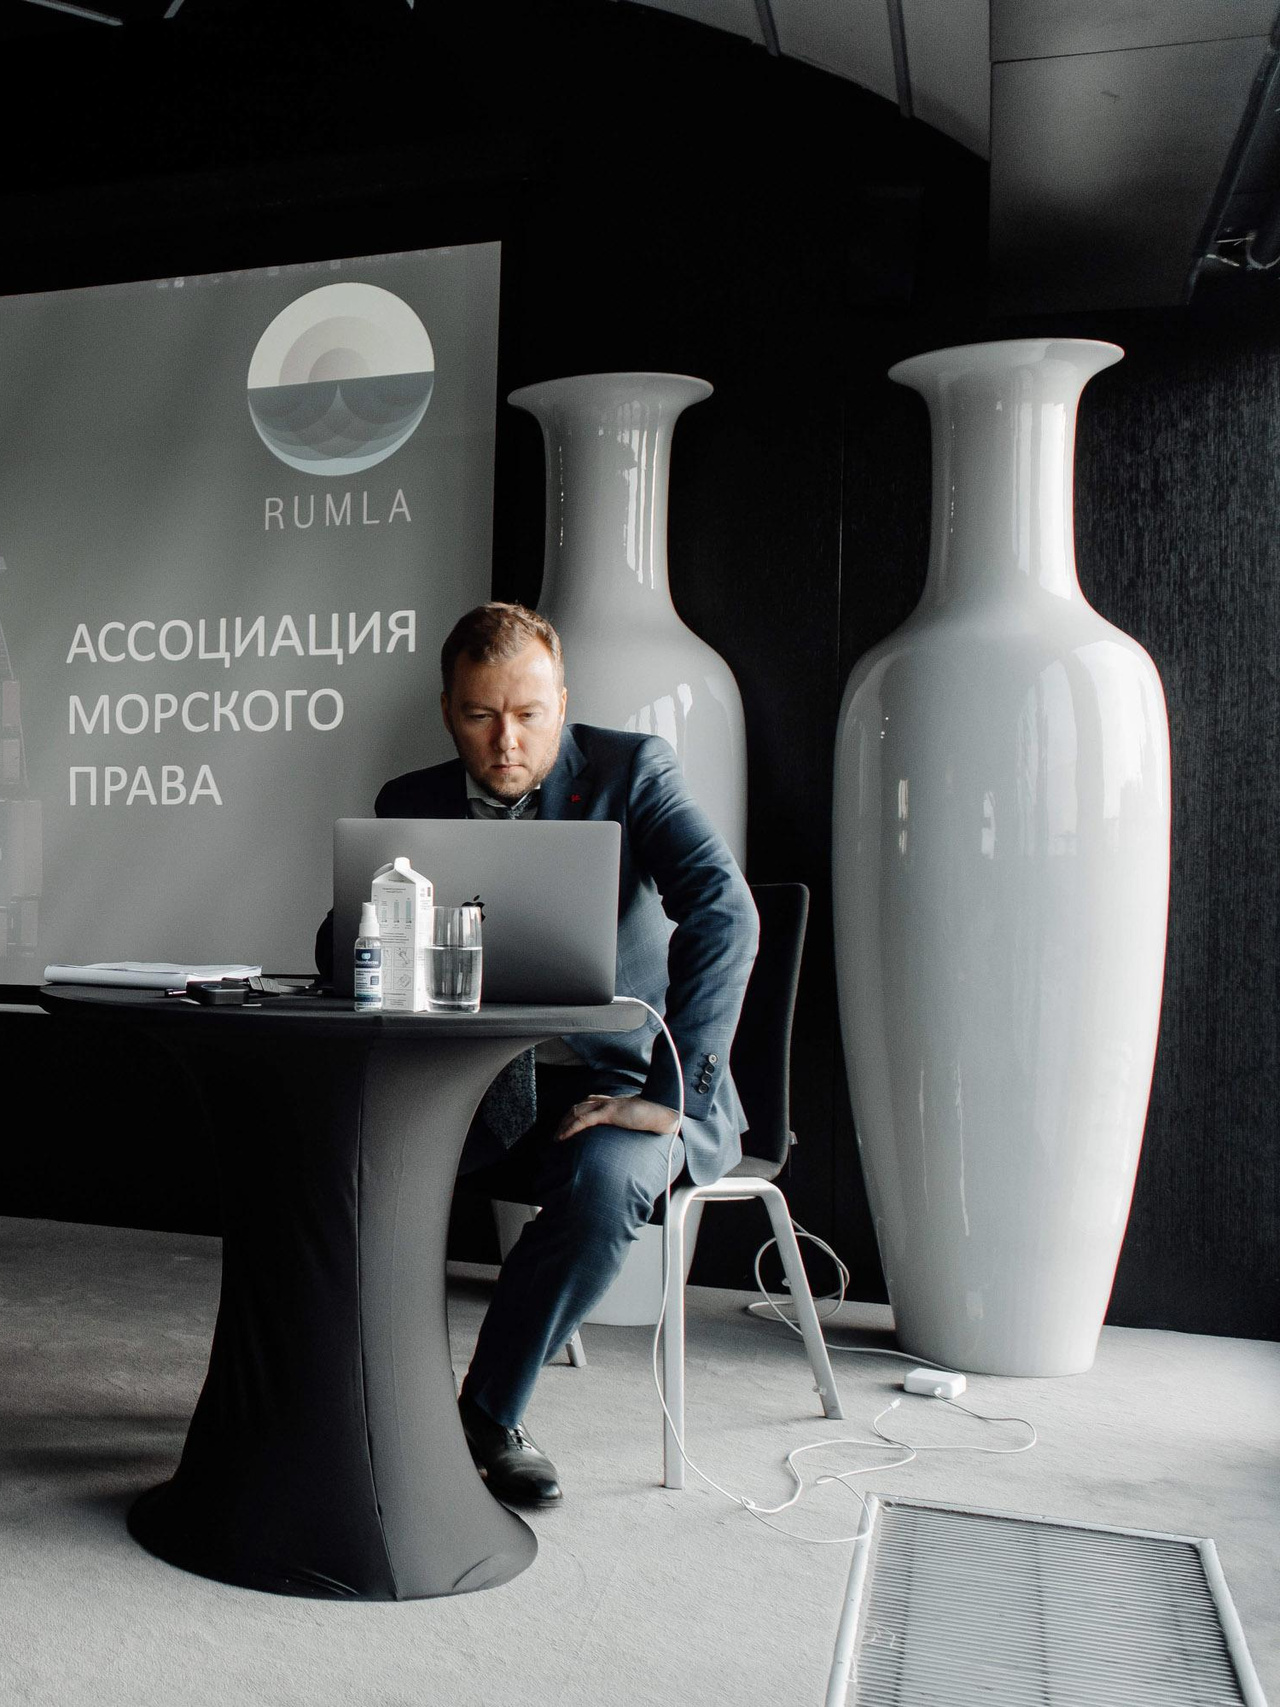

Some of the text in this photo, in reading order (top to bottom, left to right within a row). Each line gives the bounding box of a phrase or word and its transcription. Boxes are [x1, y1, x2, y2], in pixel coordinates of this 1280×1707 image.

[263, 487, 413, 532] RUMLA
[65, 609, 418, 668] АССОЦИАЦИЯ
[68, 687, 346, 736] МОРСКОГО
[68, 763, 224, 807] ПРАВА
